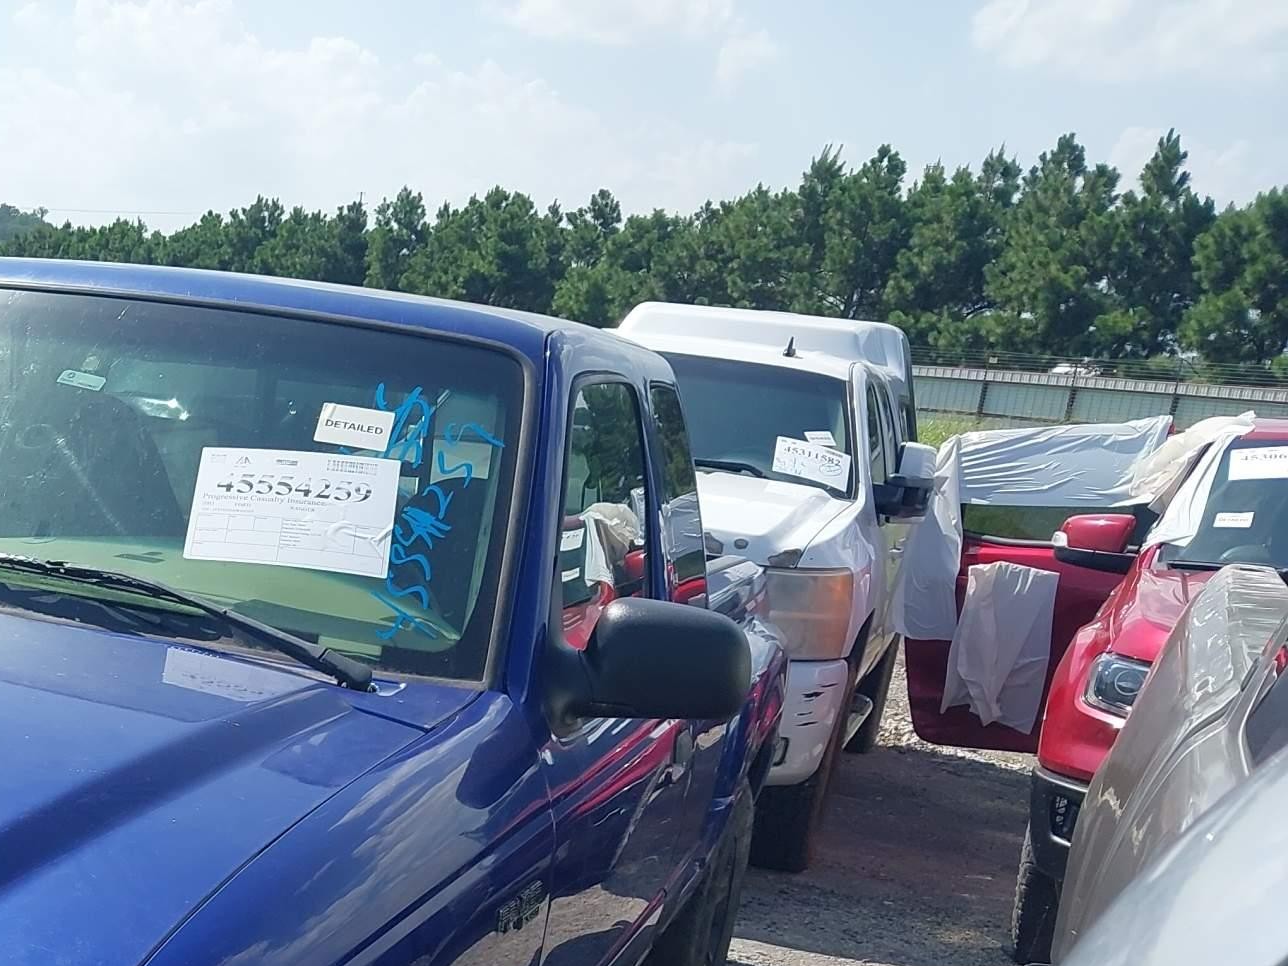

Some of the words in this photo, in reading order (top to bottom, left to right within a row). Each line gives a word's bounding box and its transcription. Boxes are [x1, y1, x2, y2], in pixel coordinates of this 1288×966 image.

[324, 418, 384, 436] DETAILED
[216, 472, 373, 504] 45554259
[202, 492, 249, 502] Progressive
[250, 494, 285, 505] Casualty
[287, 496, 324, 506] Insurance
